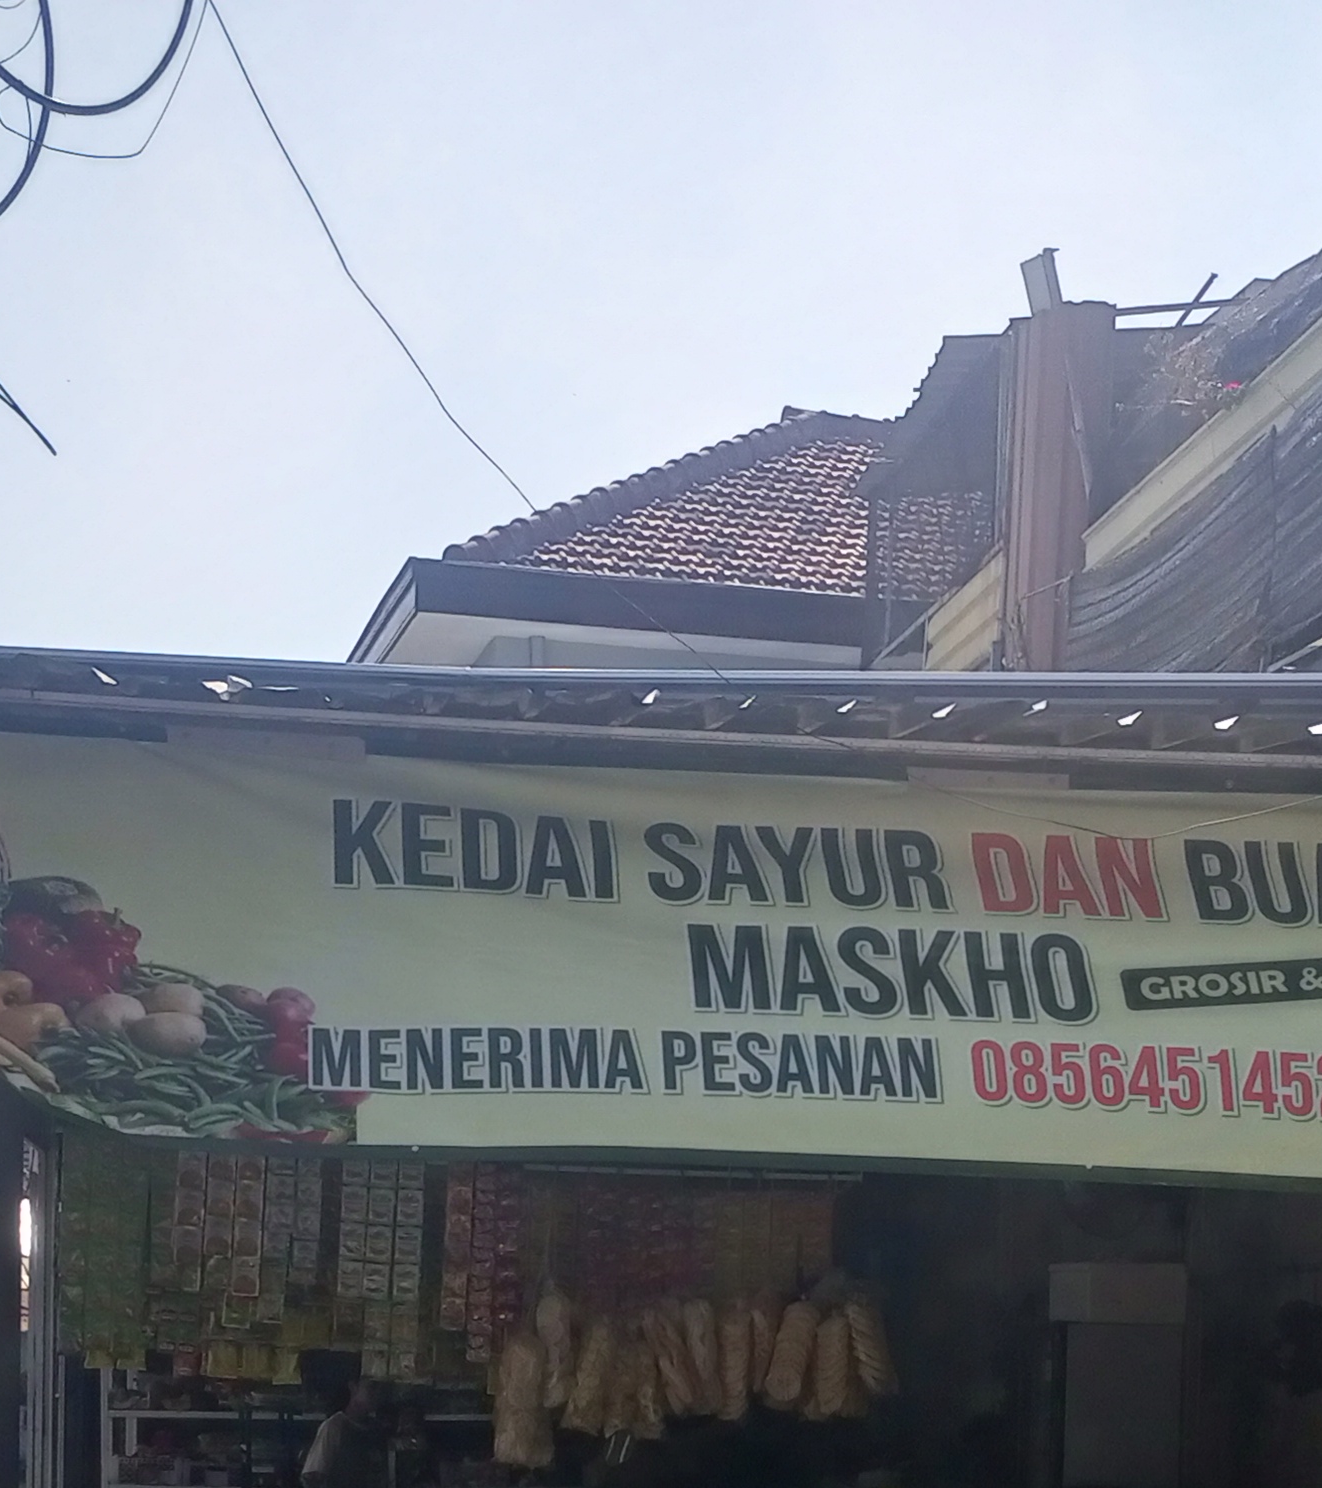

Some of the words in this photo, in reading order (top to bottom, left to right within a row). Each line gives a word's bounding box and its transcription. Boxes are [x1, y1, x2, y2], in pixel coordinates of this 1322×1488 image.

[332, 798, 620, 903] KEDAI
[643, 822, 957, 914] SAYUR
[970, 831, 1169, 922] DAN
[686, 922, 1099, 1026] MASKHO
[1139, 969, 1290, 1001] GROSIR
[307, 1026, 651, 1095] MENERIMA
[659, 1029, 944, 1103] PESANAN
